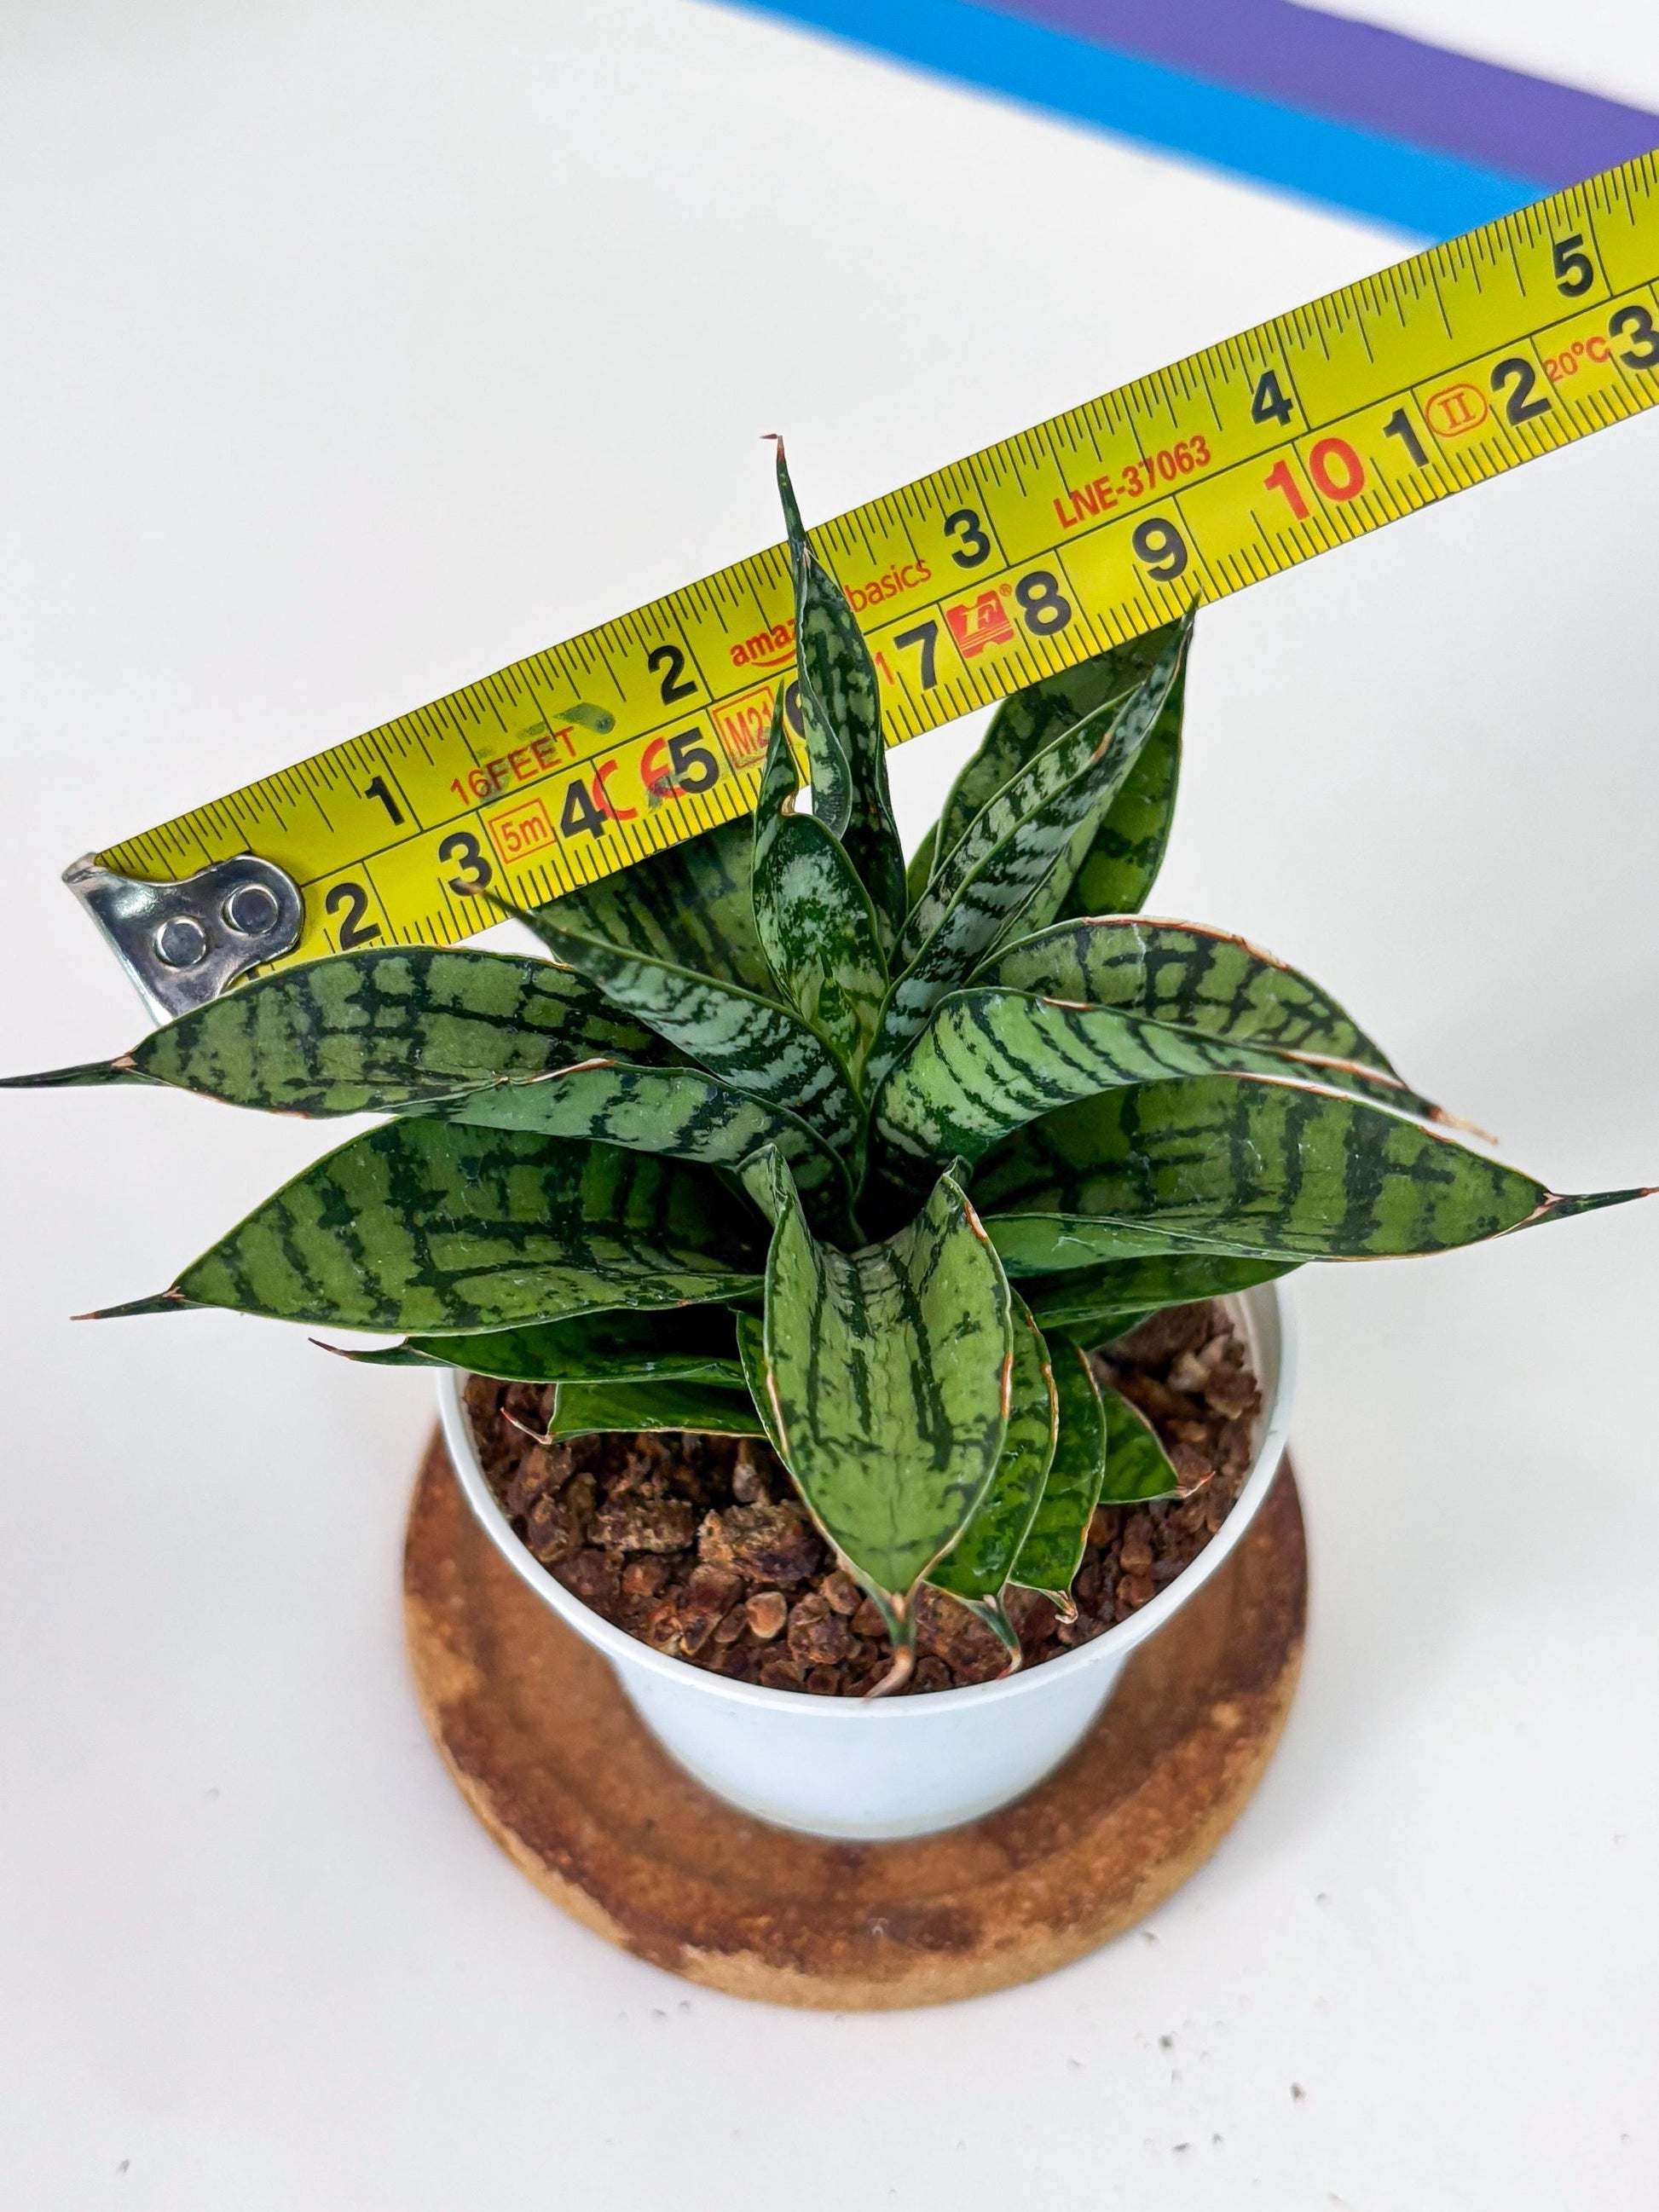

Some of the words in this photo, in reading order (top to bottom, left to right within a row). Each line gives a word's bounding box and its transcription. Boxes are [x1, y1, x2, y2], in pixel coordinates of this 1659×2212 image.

[364, 777, 405, 825] 1
[648, 644, 698, 706] 2
[945, 509, 991, 569] 3
[1251, 370, 1293, 427] 4
[1552, 234, 1594, 298] 5
[1053, 434, 1212, 530] LNE-37063
[325, 882, 382, 951] 2
[438, 832, 493, 898] 3
[560, 778, 610, 840] 4
[668, 726, 720, 794] 5
[893, 620, 939, 691] 7
[1014, 570, 1072, 637] 8
[1131, 517, 1188, 582] 9
[1263, 437, 1366, 521] 10
[1383, 408, 1431, 468] 1
[1490, 358, 1553, 425] 2
[1608, 305, 1659, 370] 3
[729, 618, 795, 667] ama
[844, 558, 933, 615] basics
[449, 725, 576, 807] 16FEET
[500, 815, 549, 852] 5m
